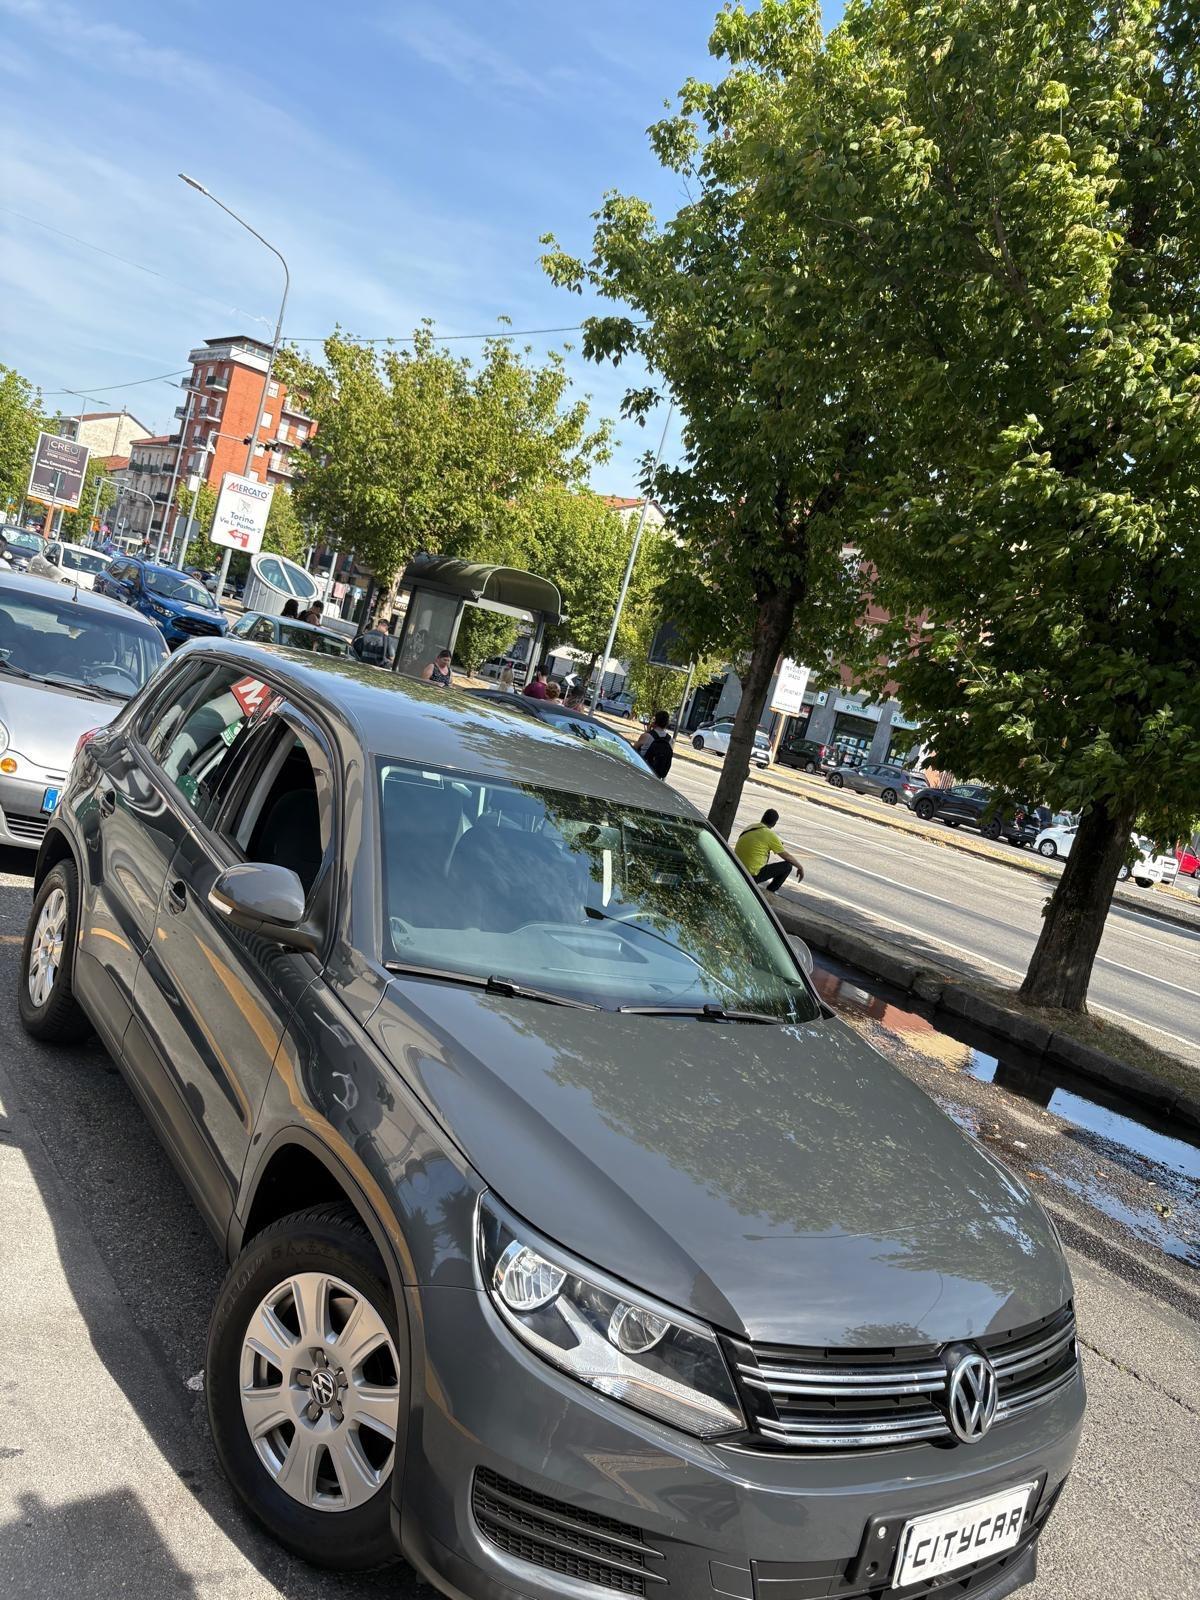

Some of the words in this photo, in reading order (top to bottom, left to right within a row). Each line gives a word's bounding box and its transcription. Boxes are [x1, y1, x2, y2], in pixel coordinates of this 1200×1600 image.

[50, 440, 79, 455] CREO
[219, 516, 230, 524] Via
[231, 511, 254, 525] Torino
[912, 1506, 1023, 1568] CITYCAR
